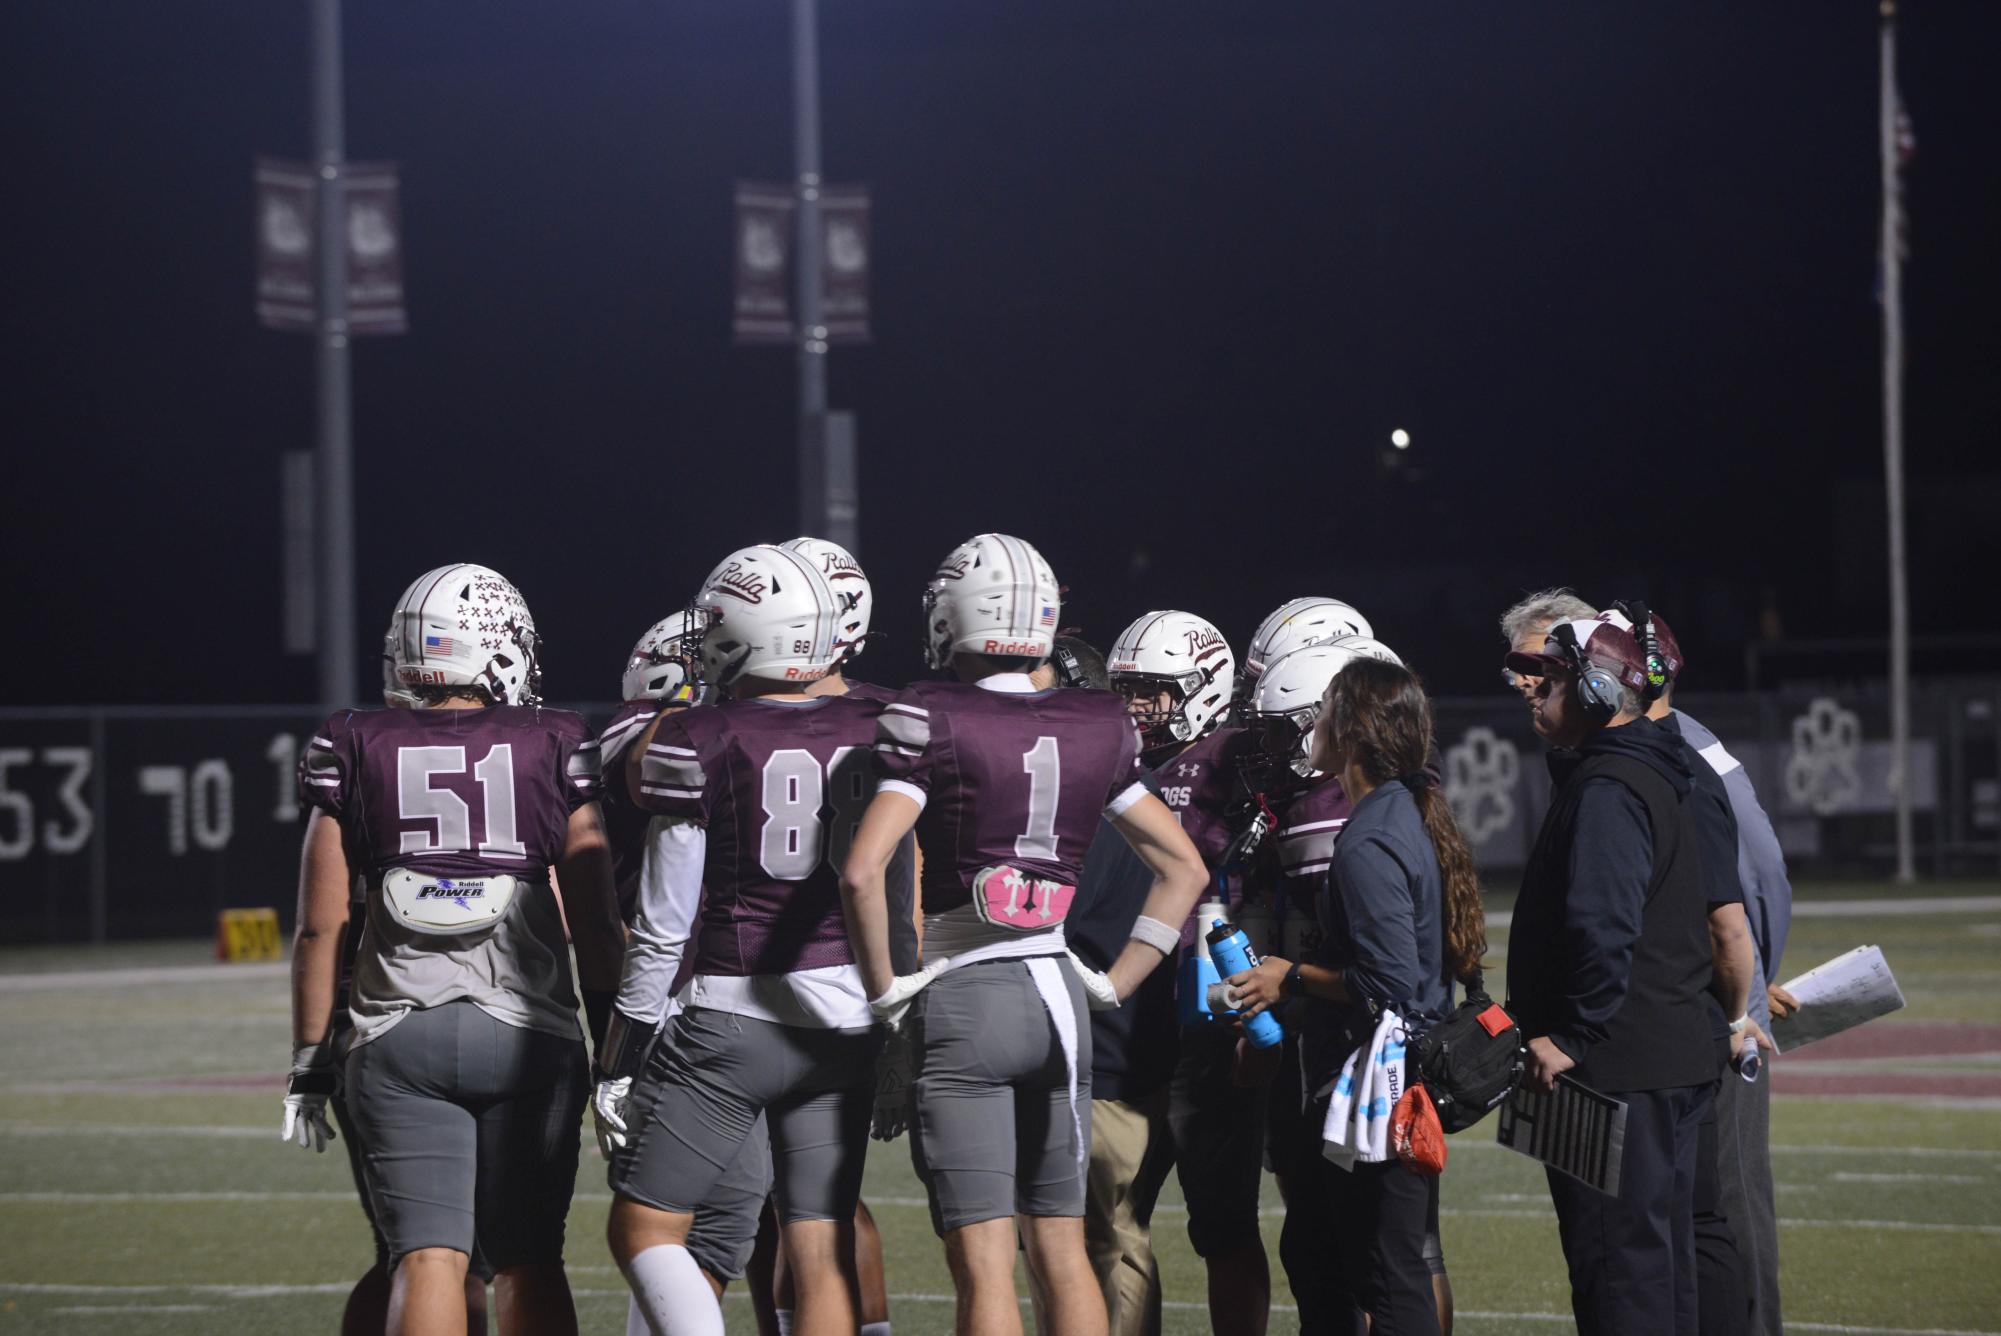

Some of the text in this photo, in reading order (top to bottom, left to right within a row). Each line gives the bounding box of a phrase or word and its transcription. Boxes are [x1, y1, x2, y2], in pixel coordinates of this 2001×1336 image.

[793, 640, 810, 654] 88
[983, 639, 1046, 656] Riddell
[0, 747, 94, 860] 53
[138, 759, 234, 855] 70
[398, 744, 526, 860] 51
[1014, 737, 1059, 861] 1
[417, 886, 484, 899] POWER
